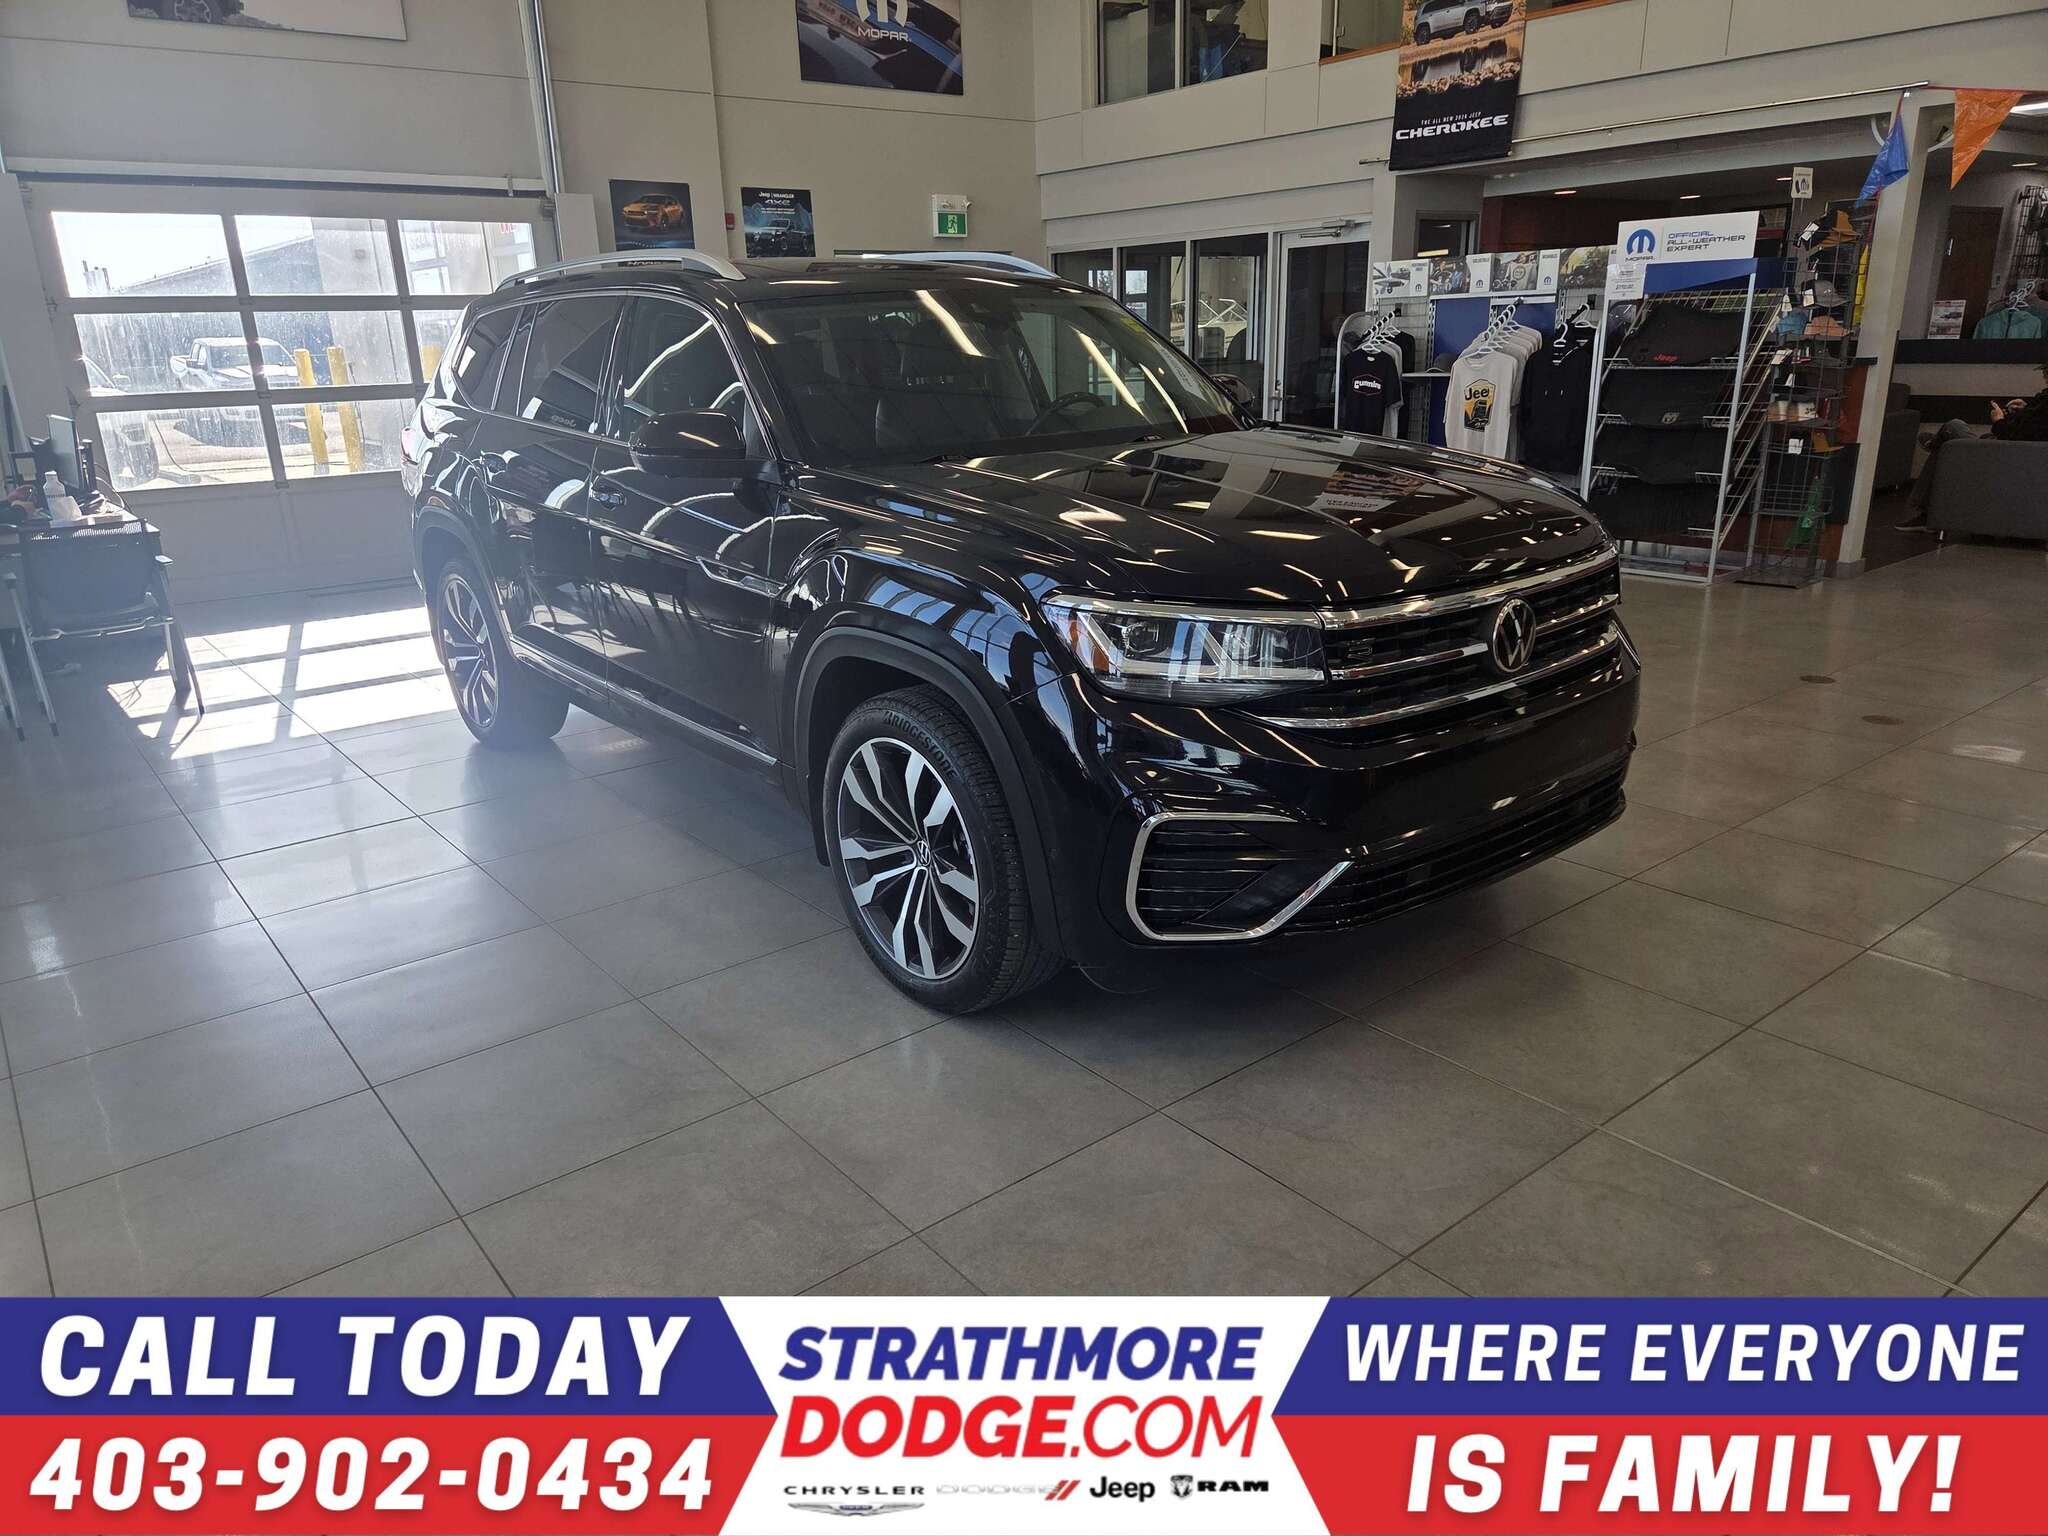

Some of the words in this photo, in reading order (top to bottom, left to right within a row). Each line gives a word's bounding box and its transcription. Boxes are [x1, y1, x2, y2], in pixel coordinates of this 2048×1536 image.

[857, 26, 909, 42] MOPAR
[1395, 115, 1509, 140] CHEROKEE
[1667, 235, 1746, 245] ALL-WEATHER
[1668, 231, 1713, 239] OFFICIAL
[1666, 244, 1710, 252] EXPERT
[1465, 388, 1489, 400] Jee
[883, 710, 958, 778] BRIDGESTONE
